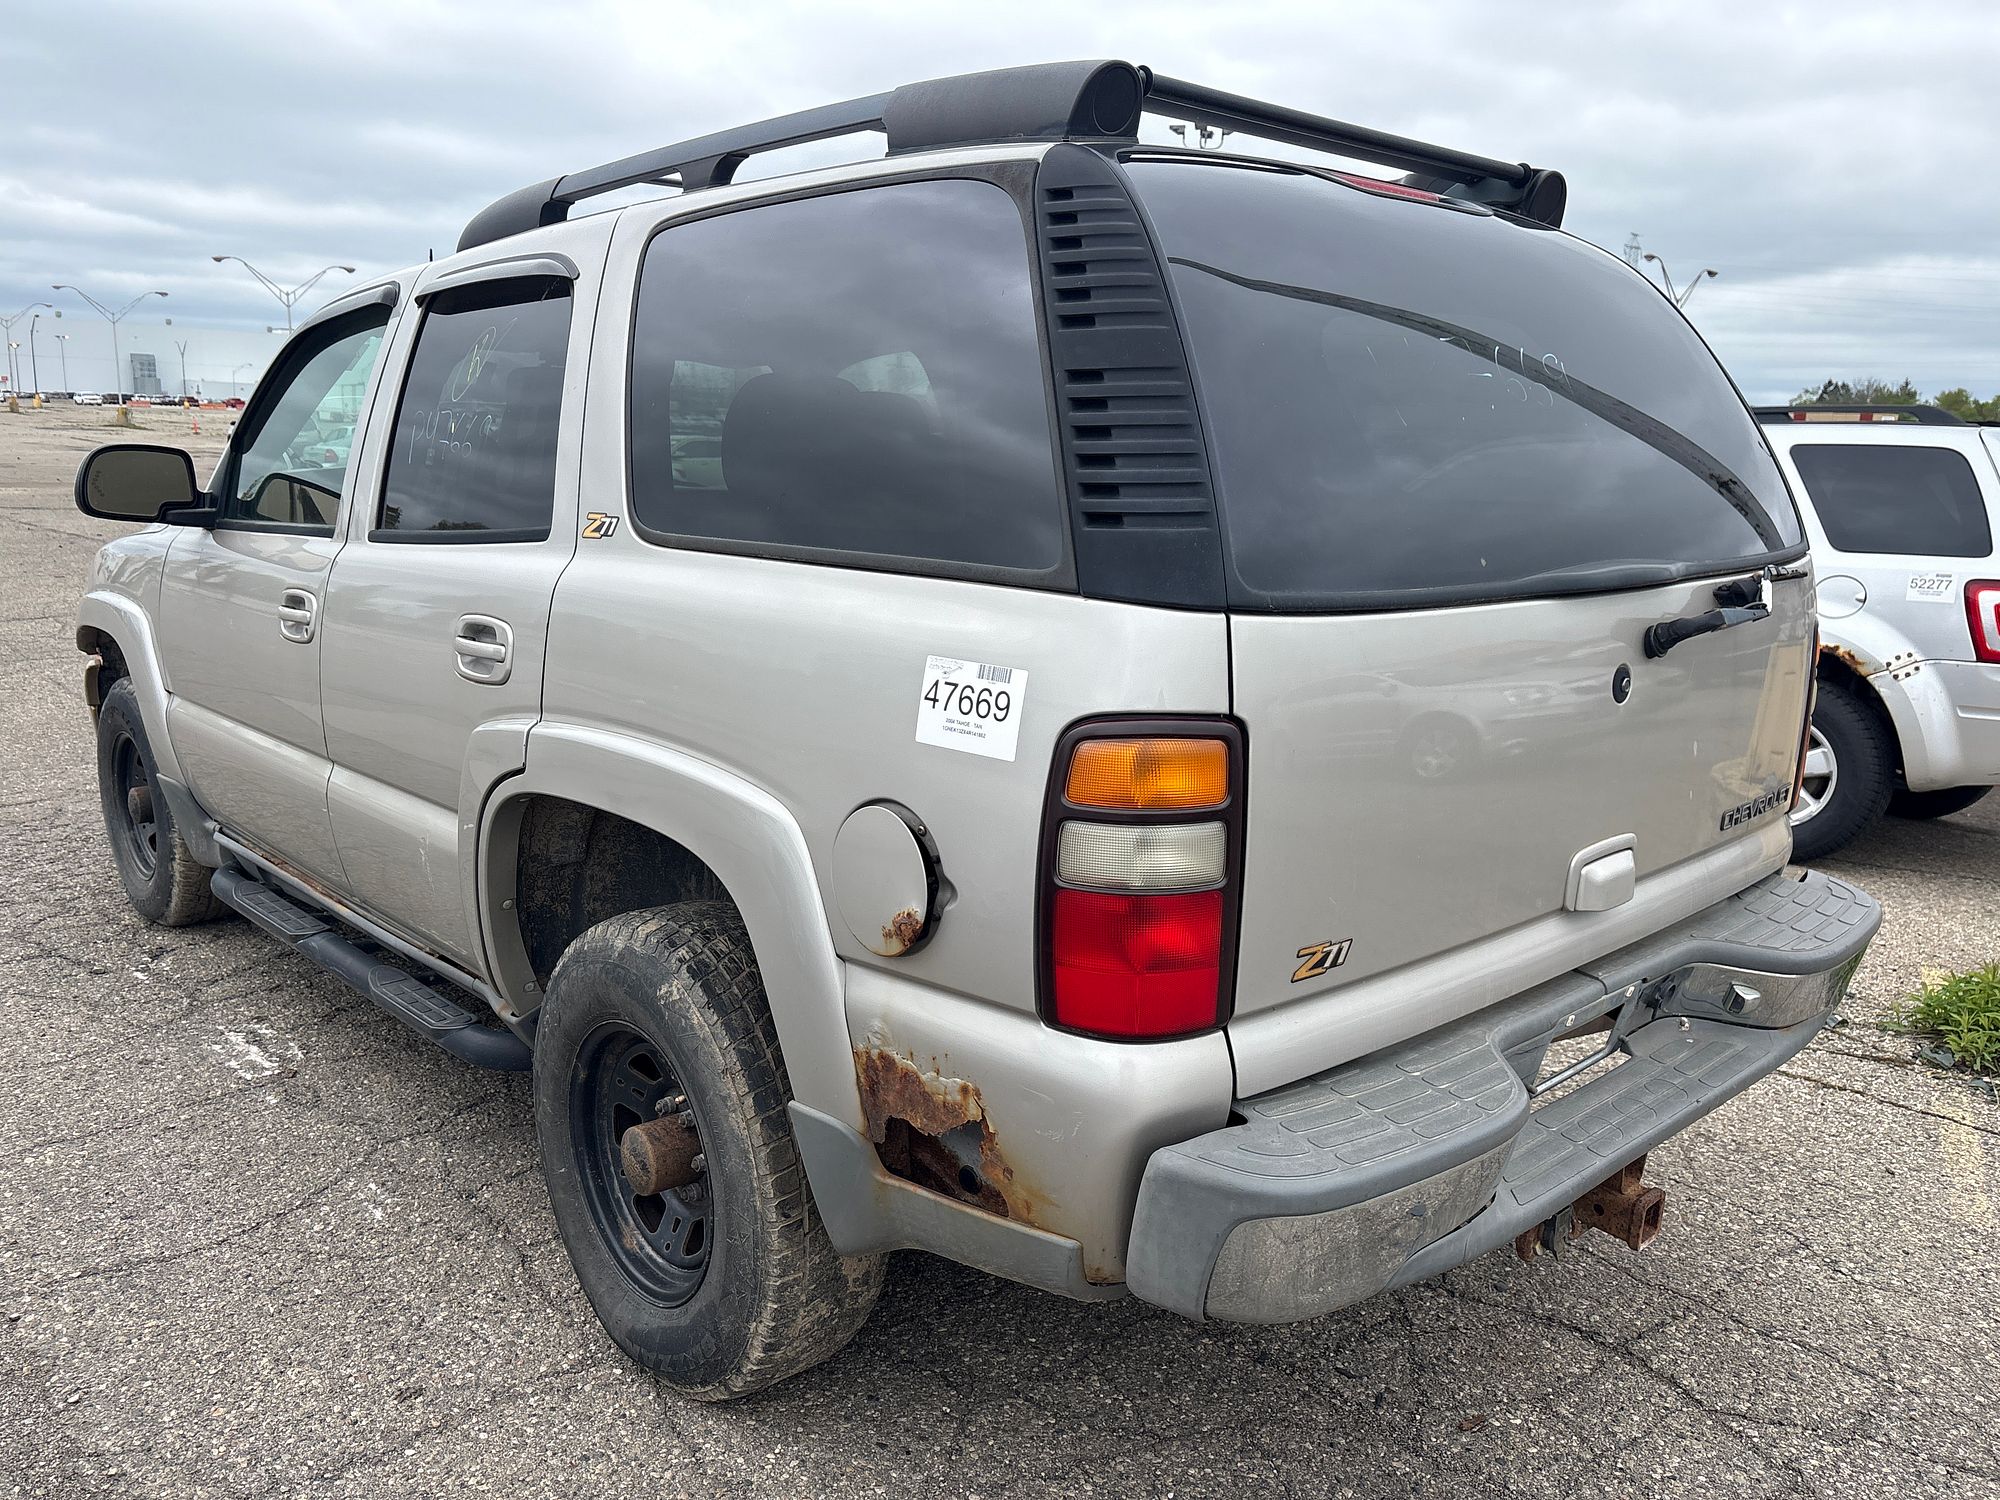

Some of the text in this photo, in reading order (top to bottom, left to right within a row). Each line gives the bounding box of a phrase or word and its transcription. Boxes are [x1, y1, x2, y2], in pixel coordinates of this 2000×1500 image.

[582, 512, 620, 539] Z71
[1910, 578, 1952, 590] 52277
[924, 679, 1011, 722] 47669
[956, 719, 971, 728] TAHOE
[974, 722, 983, 730] TAN
[1291, 938, 1353, 983] Z71
